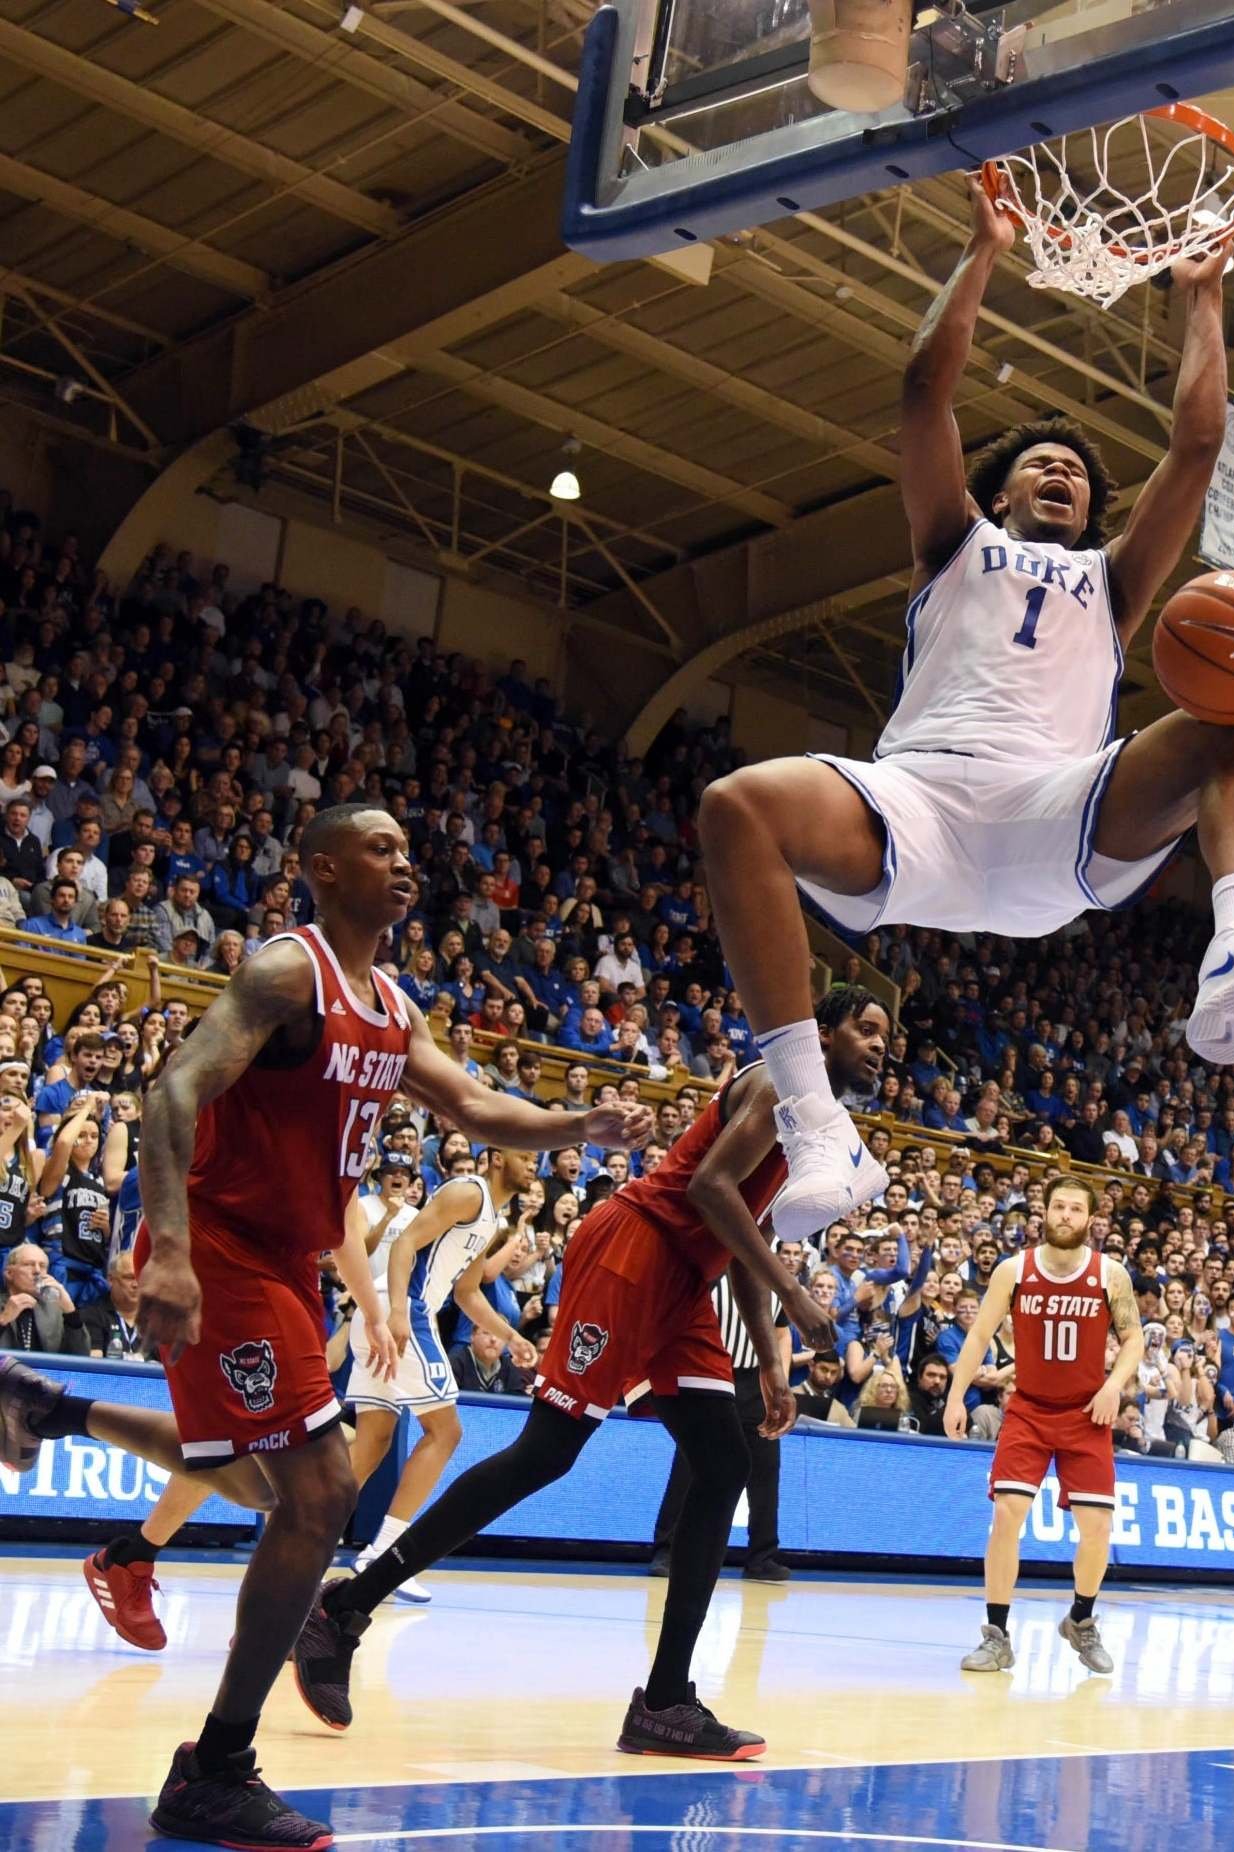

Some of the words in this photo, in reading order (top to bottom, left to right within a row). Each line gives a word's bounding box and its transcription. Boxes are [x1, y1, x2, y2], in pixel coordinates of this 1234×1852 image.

[981, 545, 1094, 611] DUKE
[1013, 586, 1047, 649] 1
[323, 1042, 359, 1085] NC
[340, 1098, 381, 1179] 13
[1019, 1293, 1044, 1315] NC
[1046, 1293, 1102, 1319] STATE
[1042, 1320, 1078, 1362] 10
[543, 1386, 578, 1411] PACK
[248, 1429, 291, 1453] PACK
